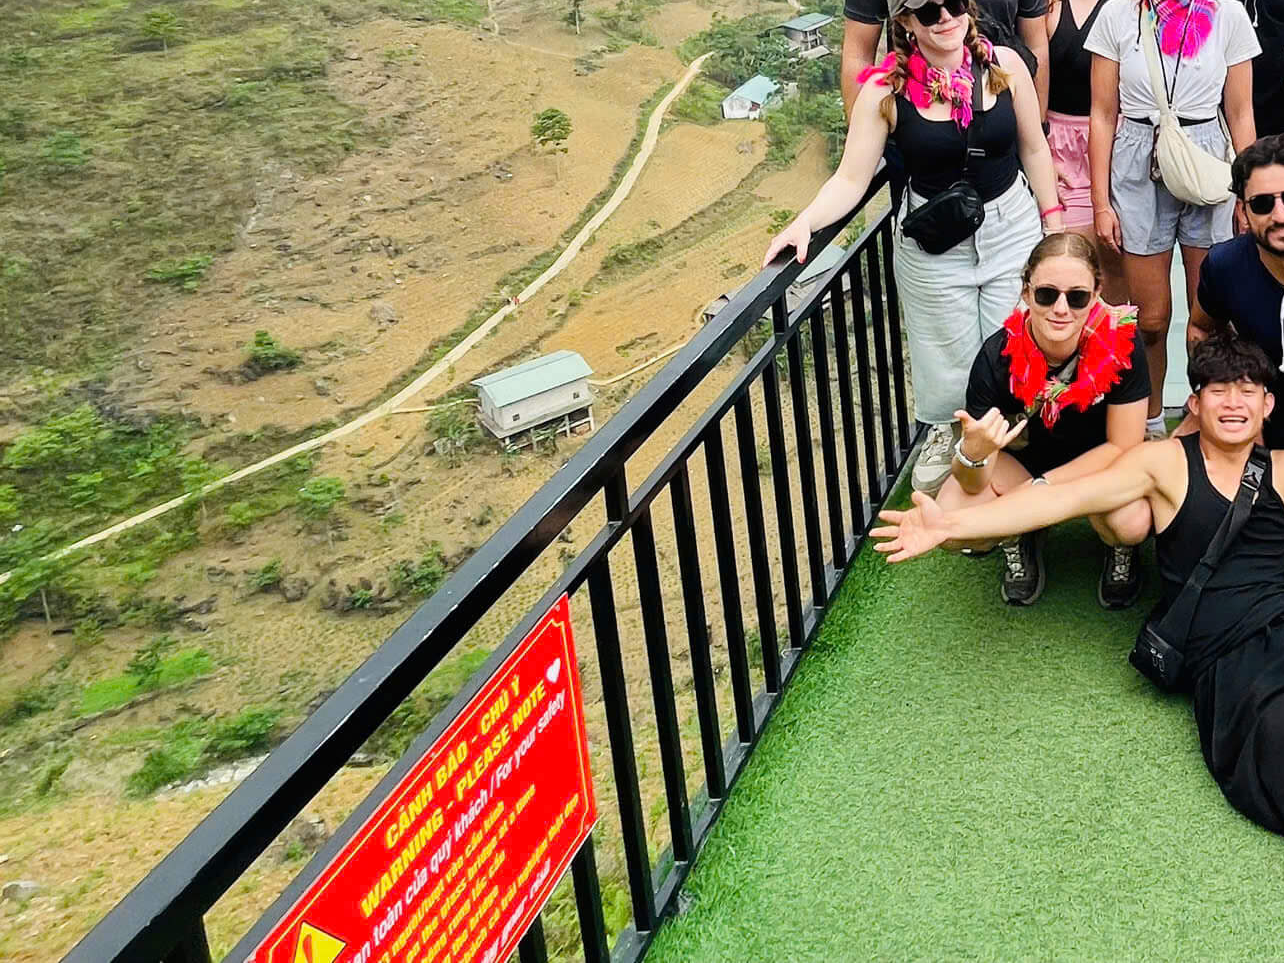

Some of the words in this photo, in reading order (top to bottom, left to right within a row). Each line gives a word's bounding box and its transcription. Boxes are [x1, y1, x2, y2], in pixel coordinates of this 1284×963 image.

[361, 807, 444, 918] WARNING
[456, 723, 511, 801] PLEASE
[512, 679, 546, 732] NOTE
[495, 756, 513, 788] For
[514, 726, 537, 769] your
[537, 689, 565, 733] safety
